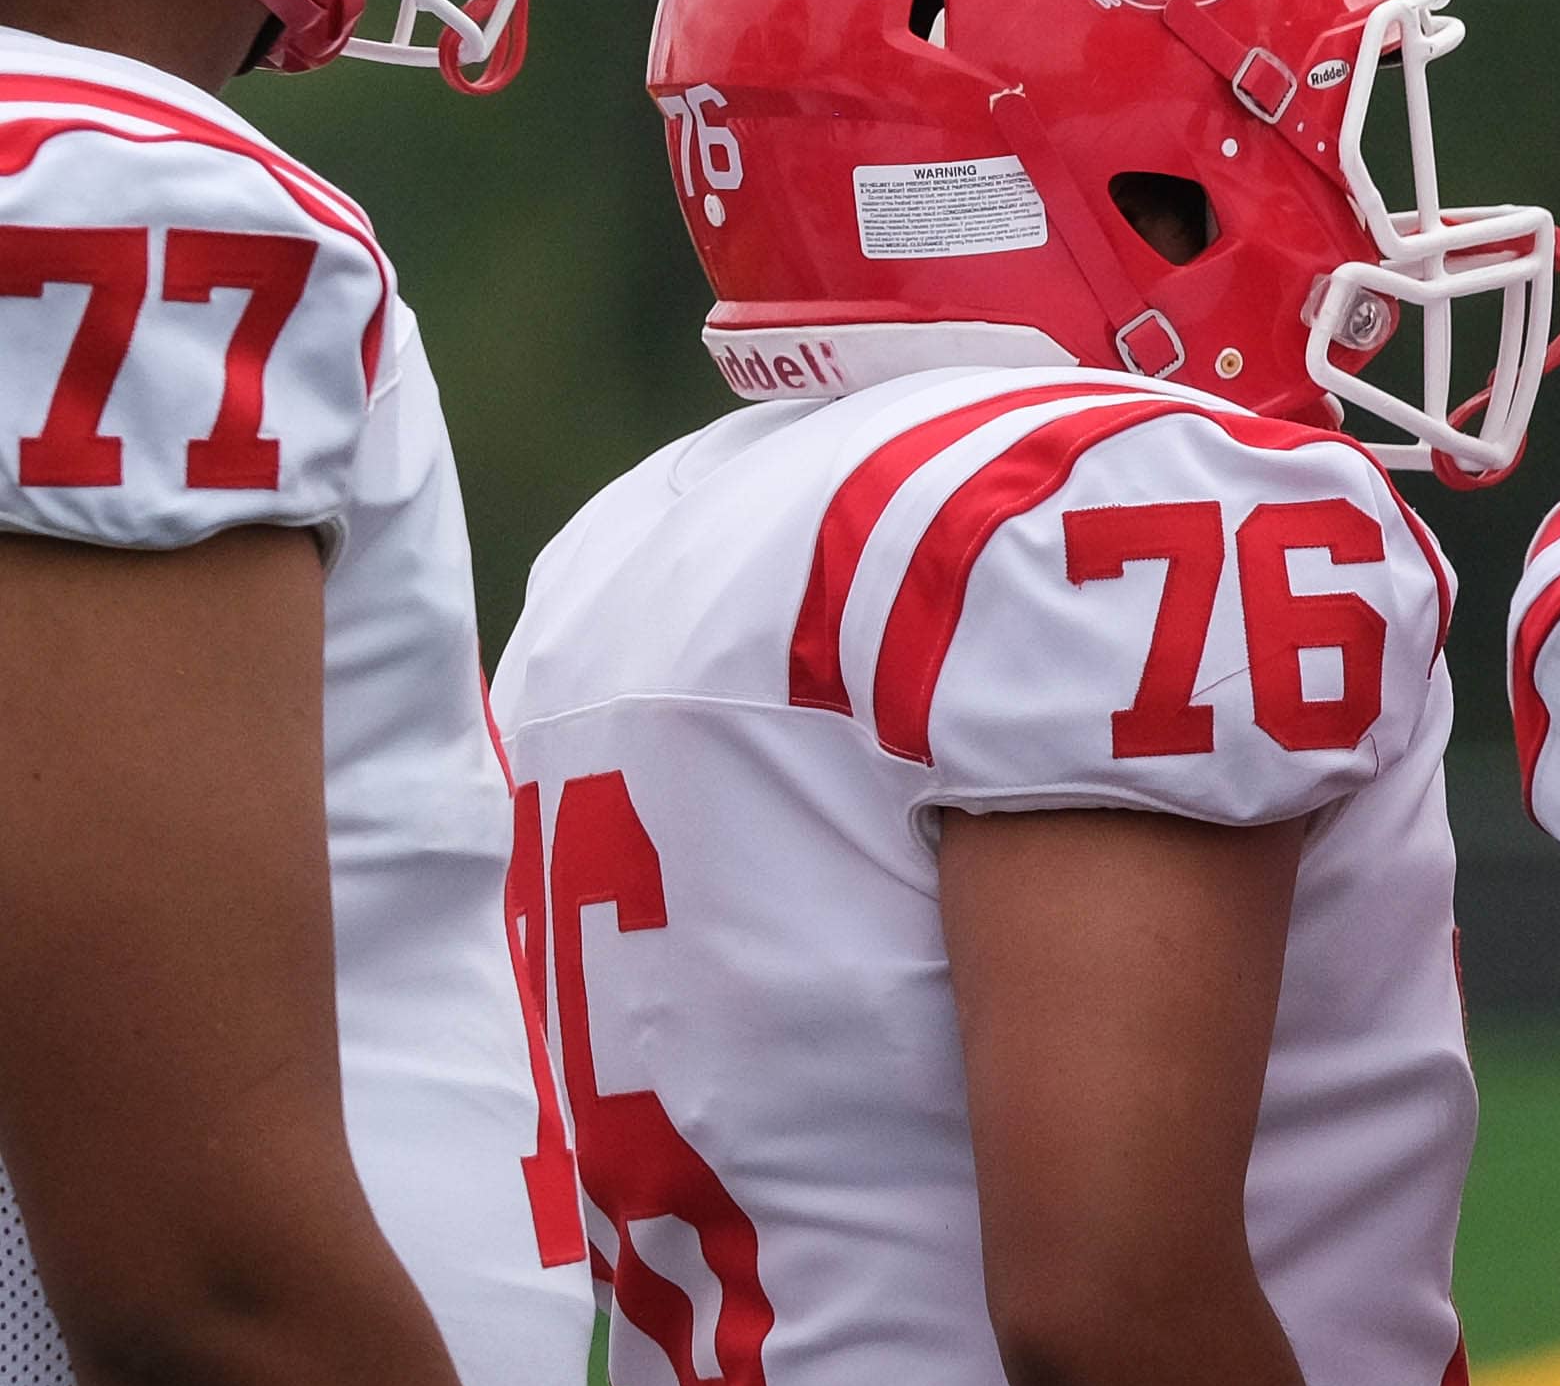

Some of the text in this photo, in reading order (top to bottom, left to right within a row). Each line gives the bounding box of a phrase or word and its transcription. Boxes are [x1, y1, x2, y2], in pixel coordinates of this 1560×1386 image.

[1311, 63, 1349, 86] Riddell
[658, 82, 744, 198] 76
[913, 164, 977, 180] WARNING
[0, 225, 319, 491] 77
[1062, 498, 1388, 759] 76
